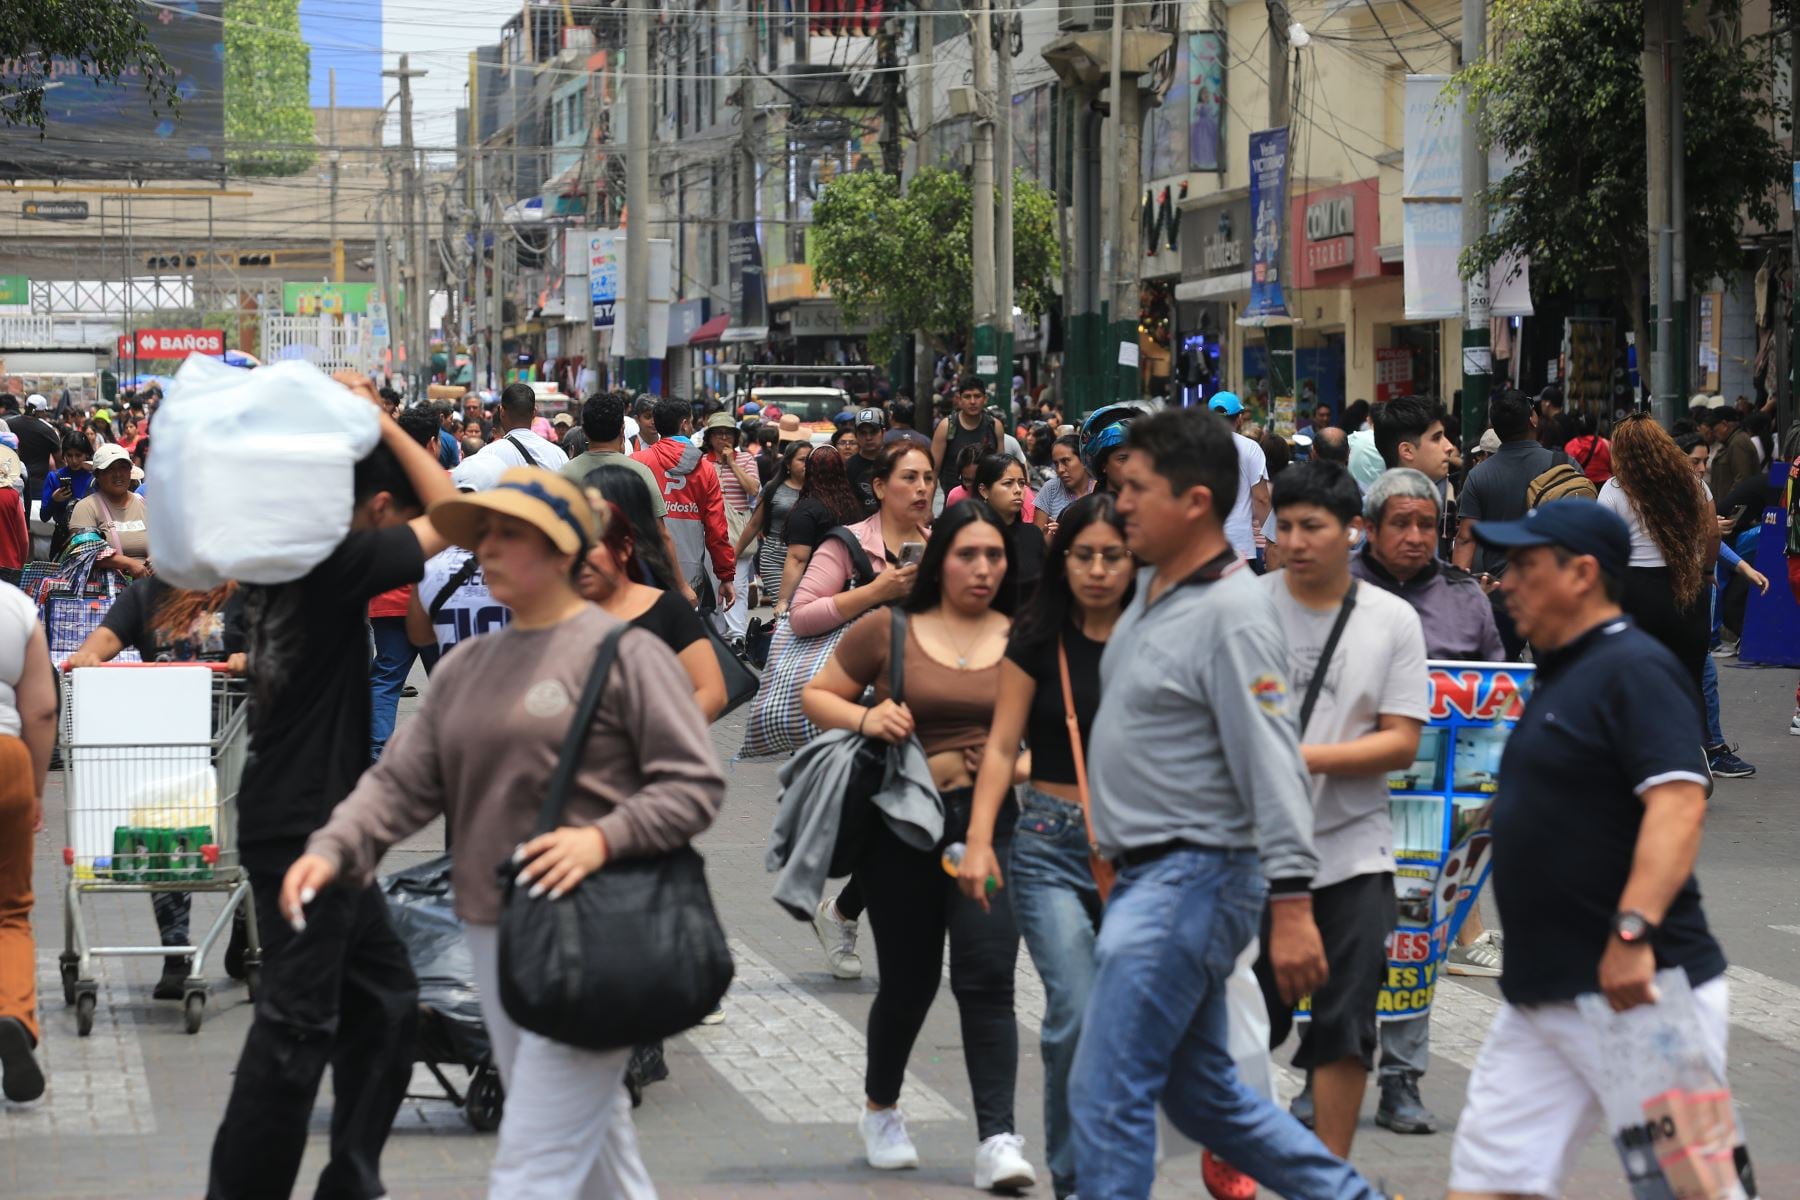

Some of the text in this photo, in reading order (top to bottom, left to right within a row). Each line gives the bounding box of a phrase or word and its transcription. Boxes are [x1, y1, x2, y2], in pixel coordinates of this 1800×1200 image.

[1308, 242, 1345, 268] STORE
[160, 333, 219, 350] BAÑOS
[665, 501, 699, 513] idosYa
[1384, 966, 1419, 988] ES
